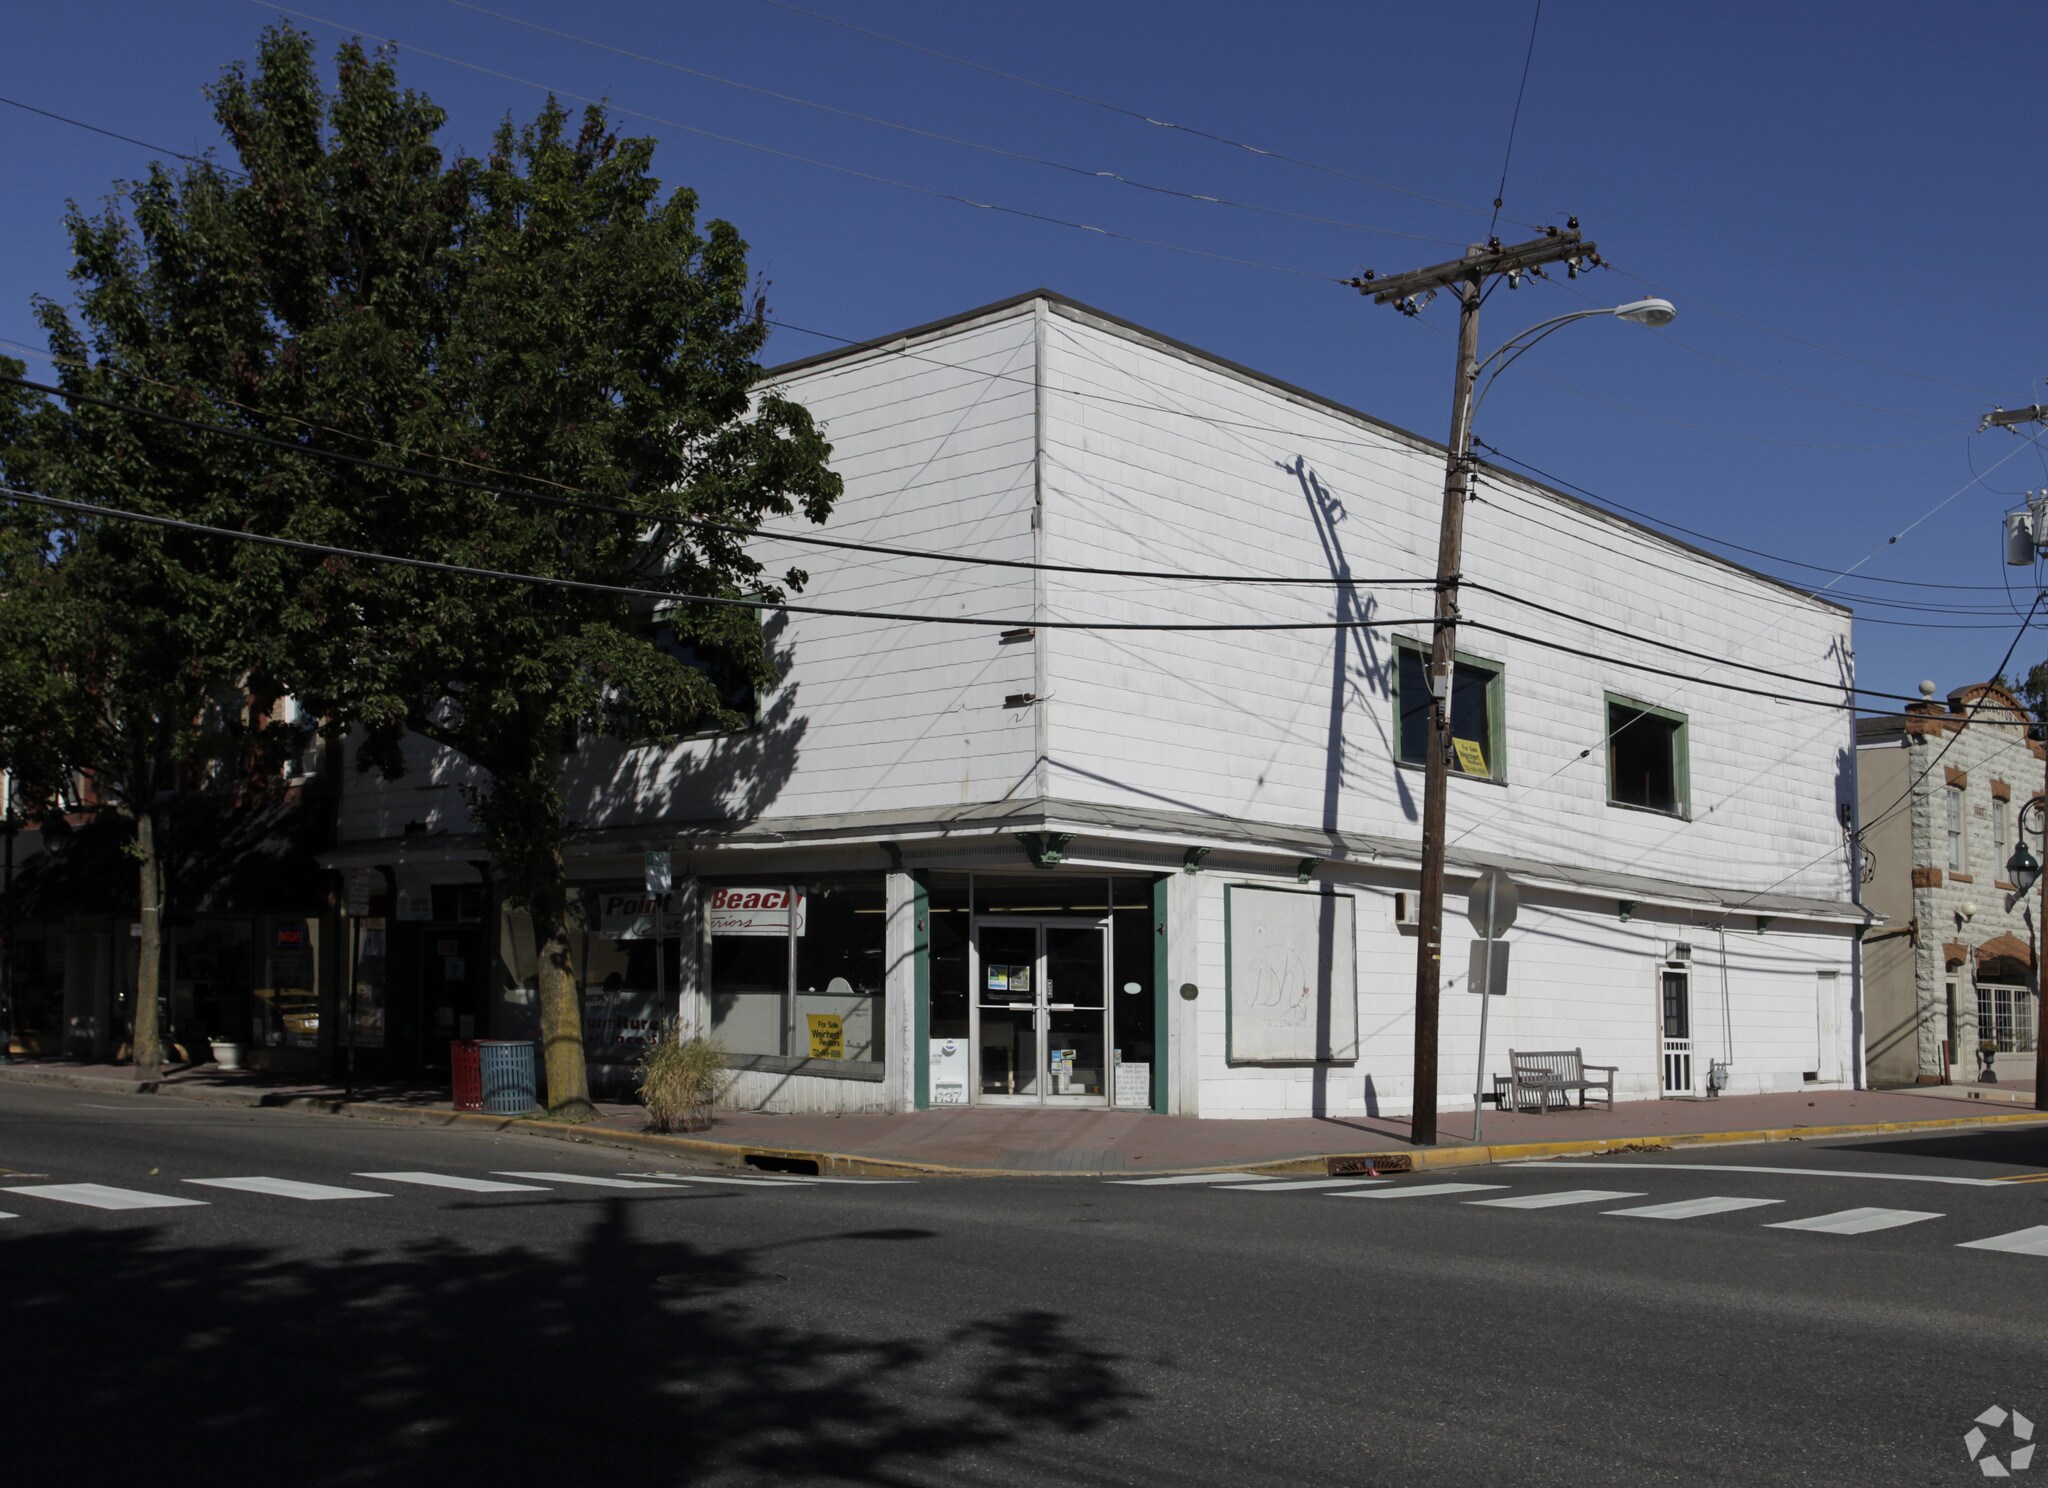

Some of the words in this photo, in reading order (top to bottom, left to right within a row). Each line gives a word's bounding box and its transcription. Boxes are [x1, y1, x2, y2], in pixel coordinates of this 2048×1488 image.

[606, 893, 672, 915] Point
[712, 888, 803, 909] Beach
[817, 1020, 826, 1028] For
